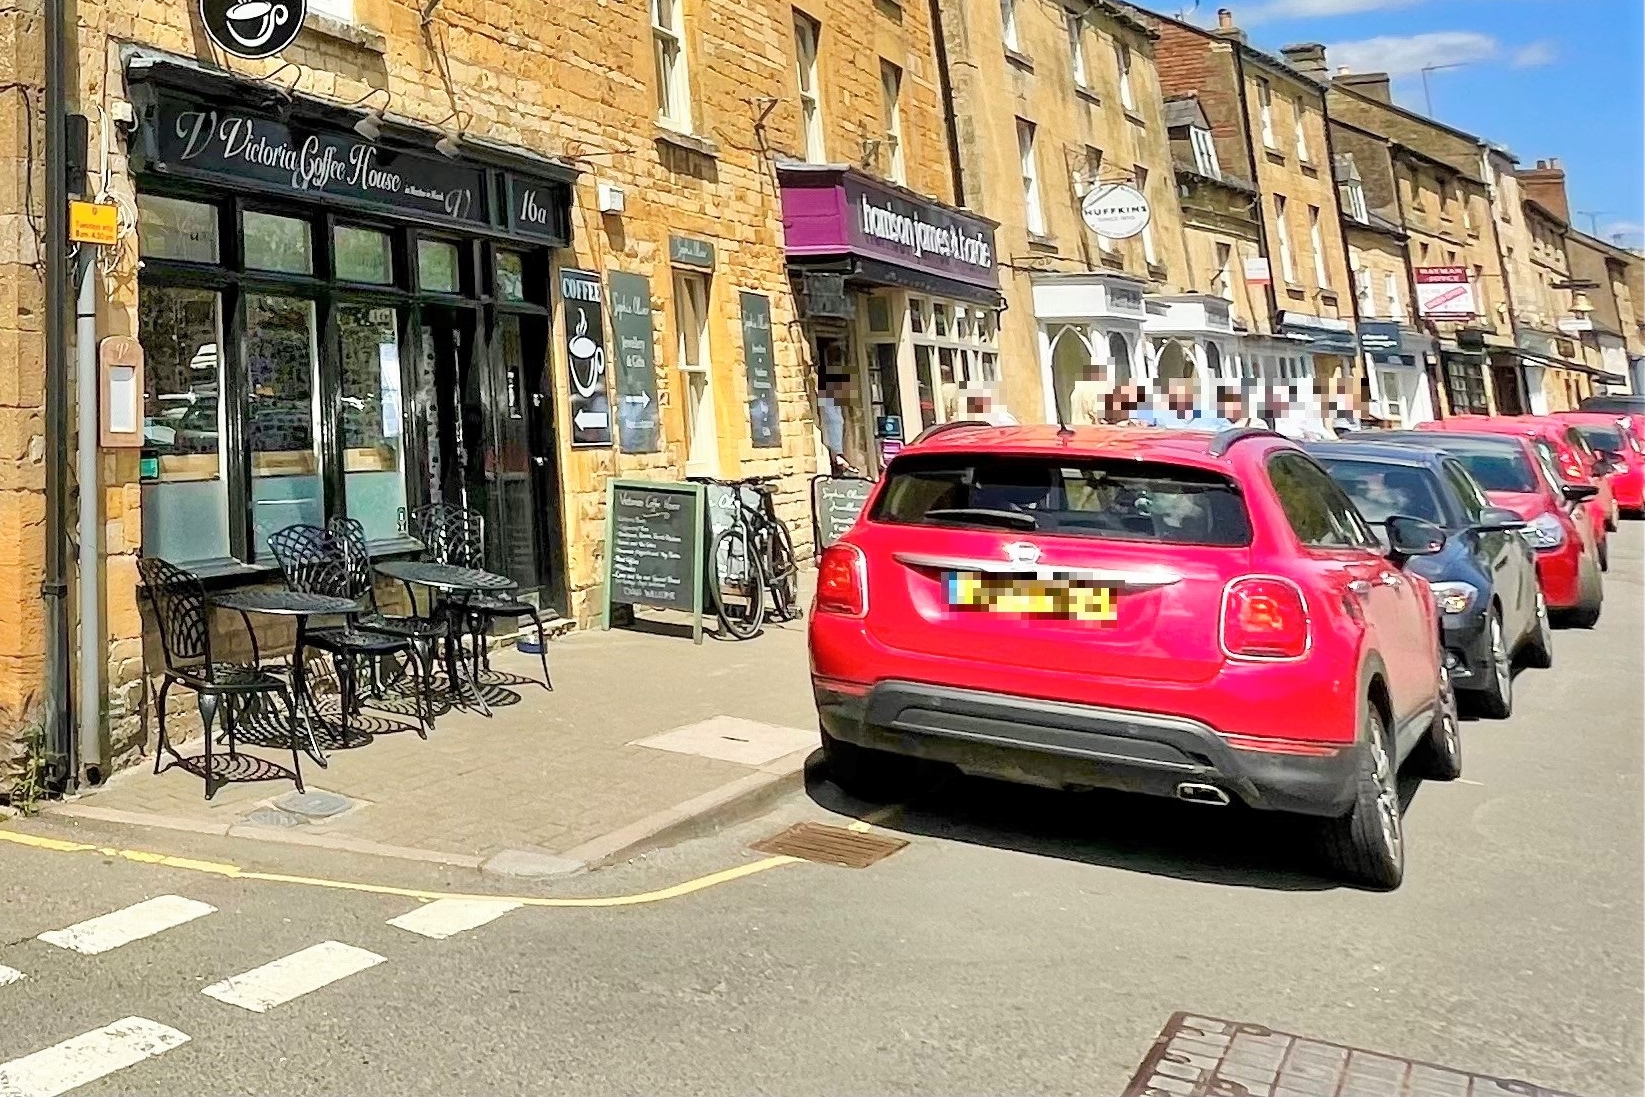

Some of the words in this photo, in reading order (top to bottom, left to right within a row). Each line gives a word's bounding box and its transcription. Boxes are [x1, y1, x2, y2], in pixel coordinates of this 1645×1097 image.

[219, 117, 299, 172] Victoria
[294, 135, 347, 189] Coffee
[346, 144, 402, 192] House
[520, 189, 548, 225] 16a
[562, 276, 601, 303] COFFEE
